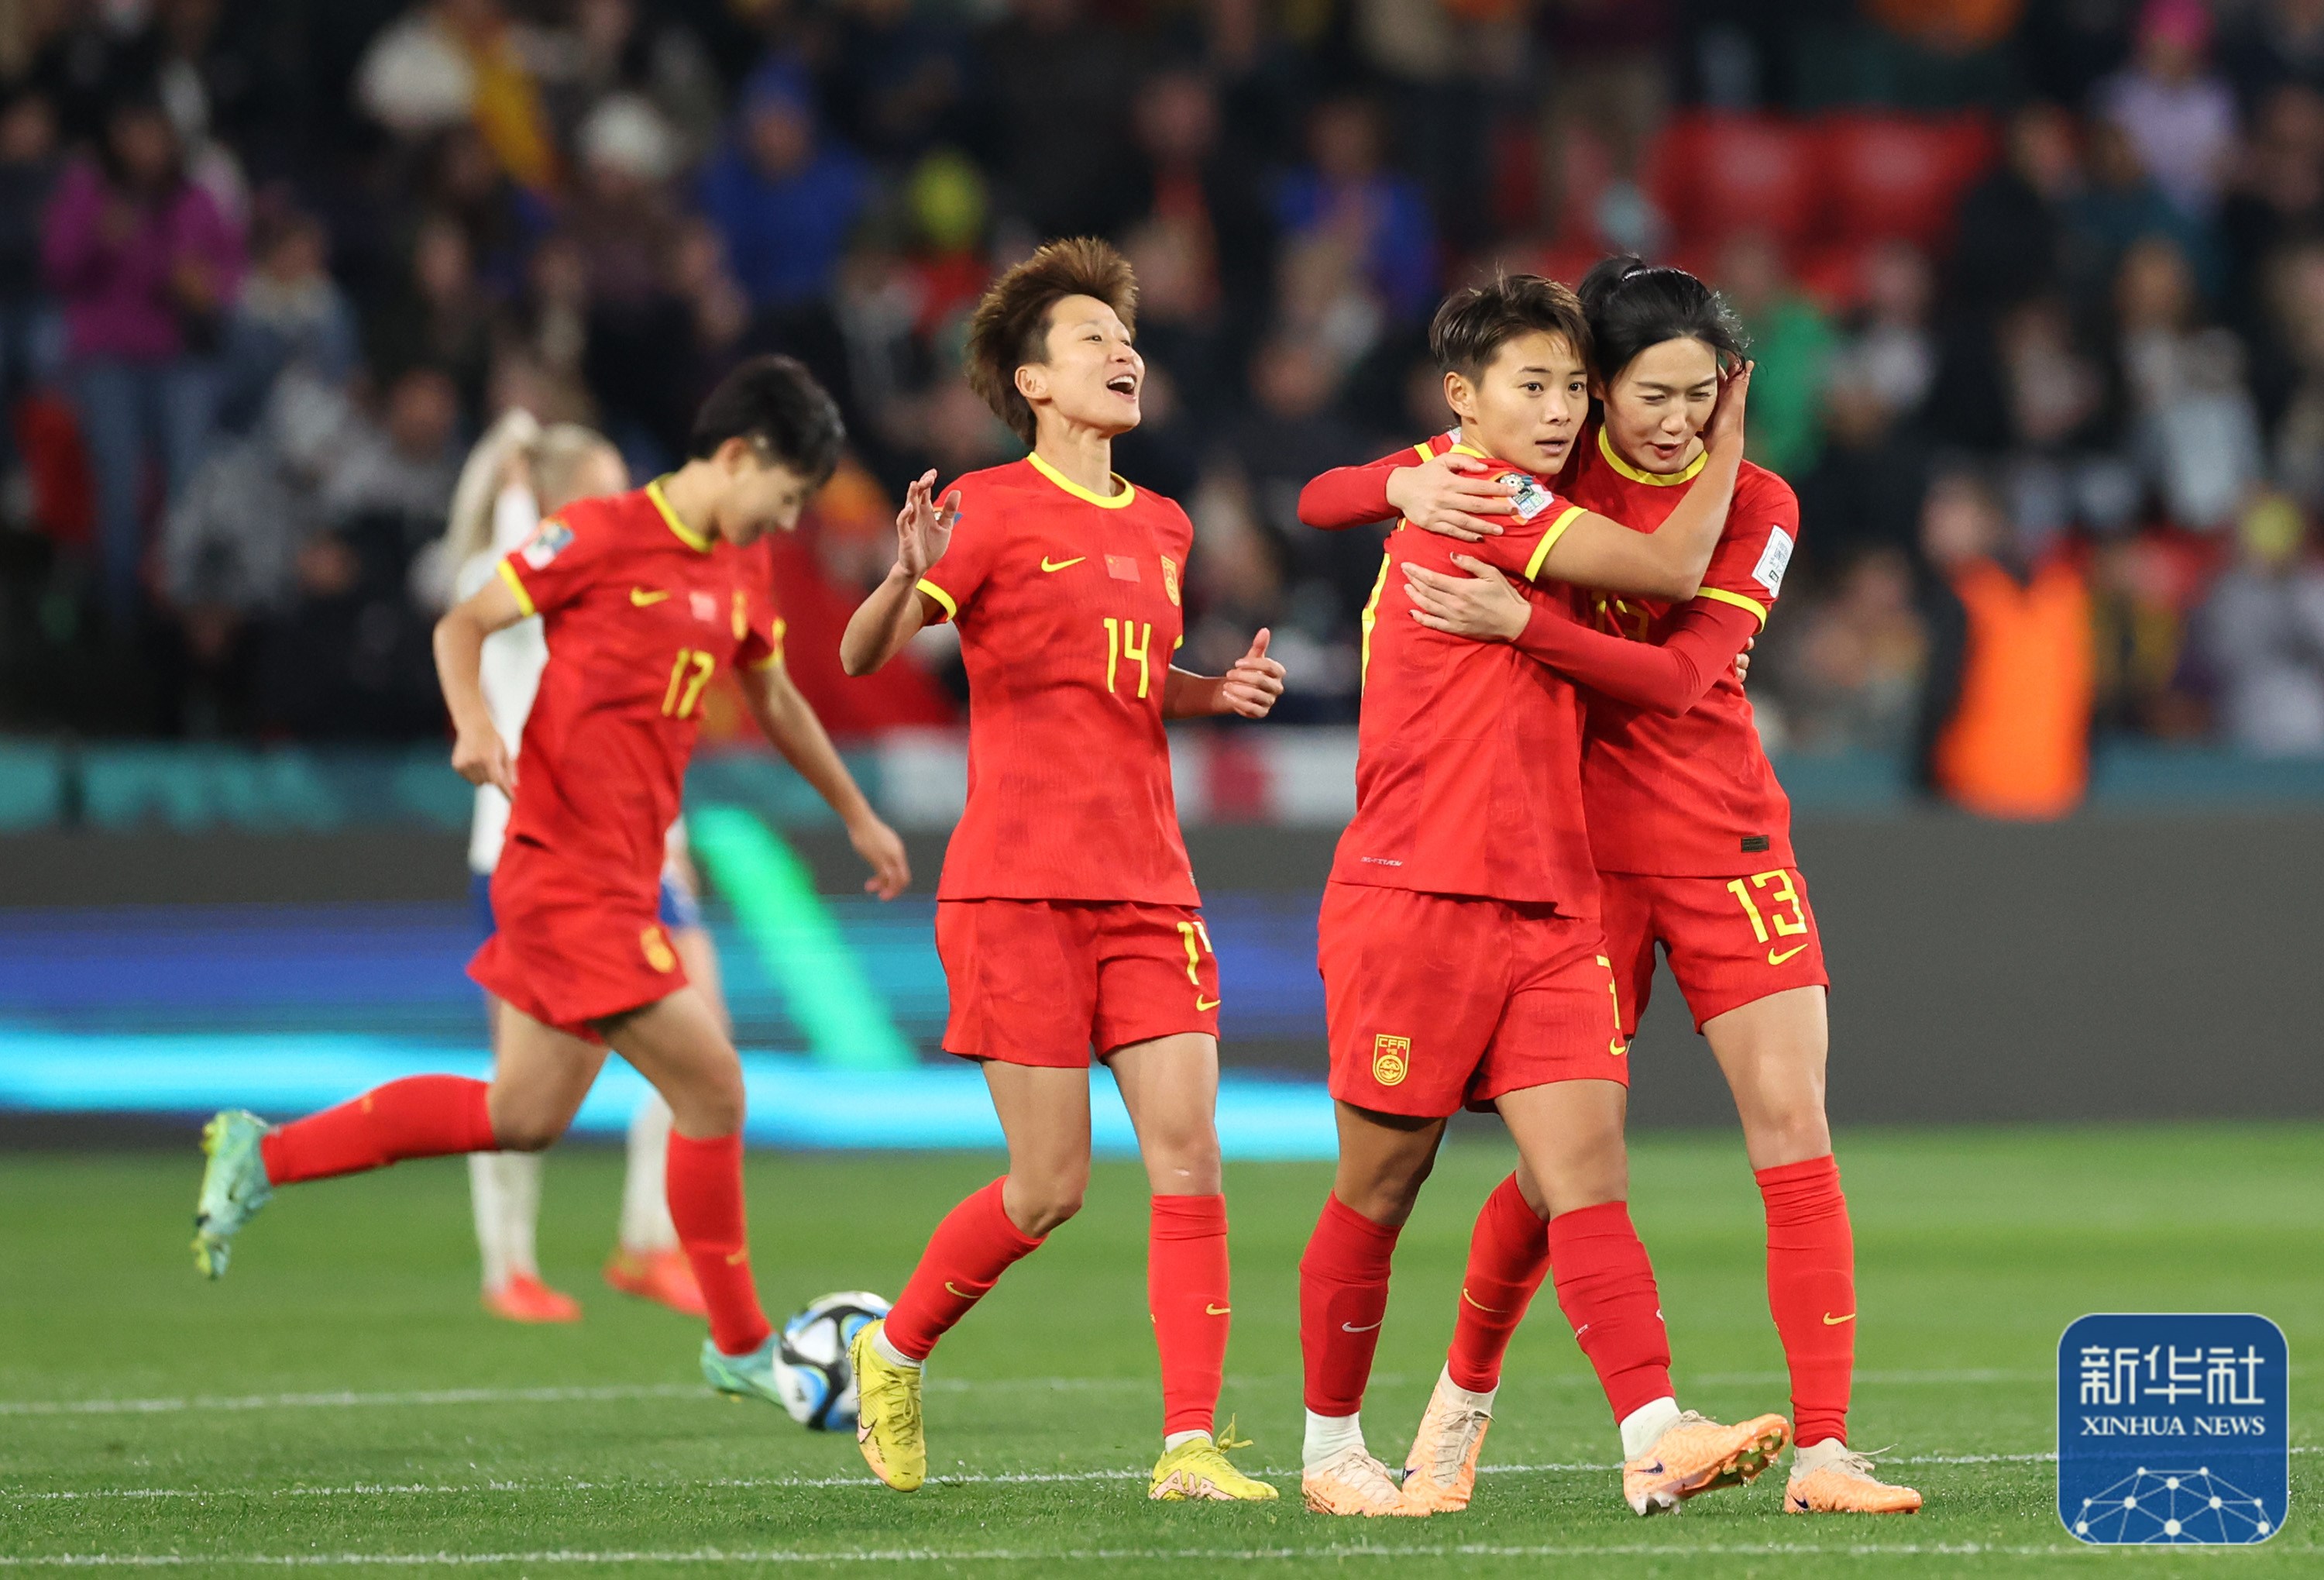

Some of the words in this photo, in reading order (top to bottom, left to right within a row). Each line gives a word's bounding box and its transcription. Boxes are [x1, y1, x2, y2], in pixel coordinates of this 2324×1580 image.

[661, 647, 716, 719] 17
[1103, 618, 1152, 698] 14
[1727, 868, 1808, 944] 13
[1378, 1038, 1408, 1050] CFA
